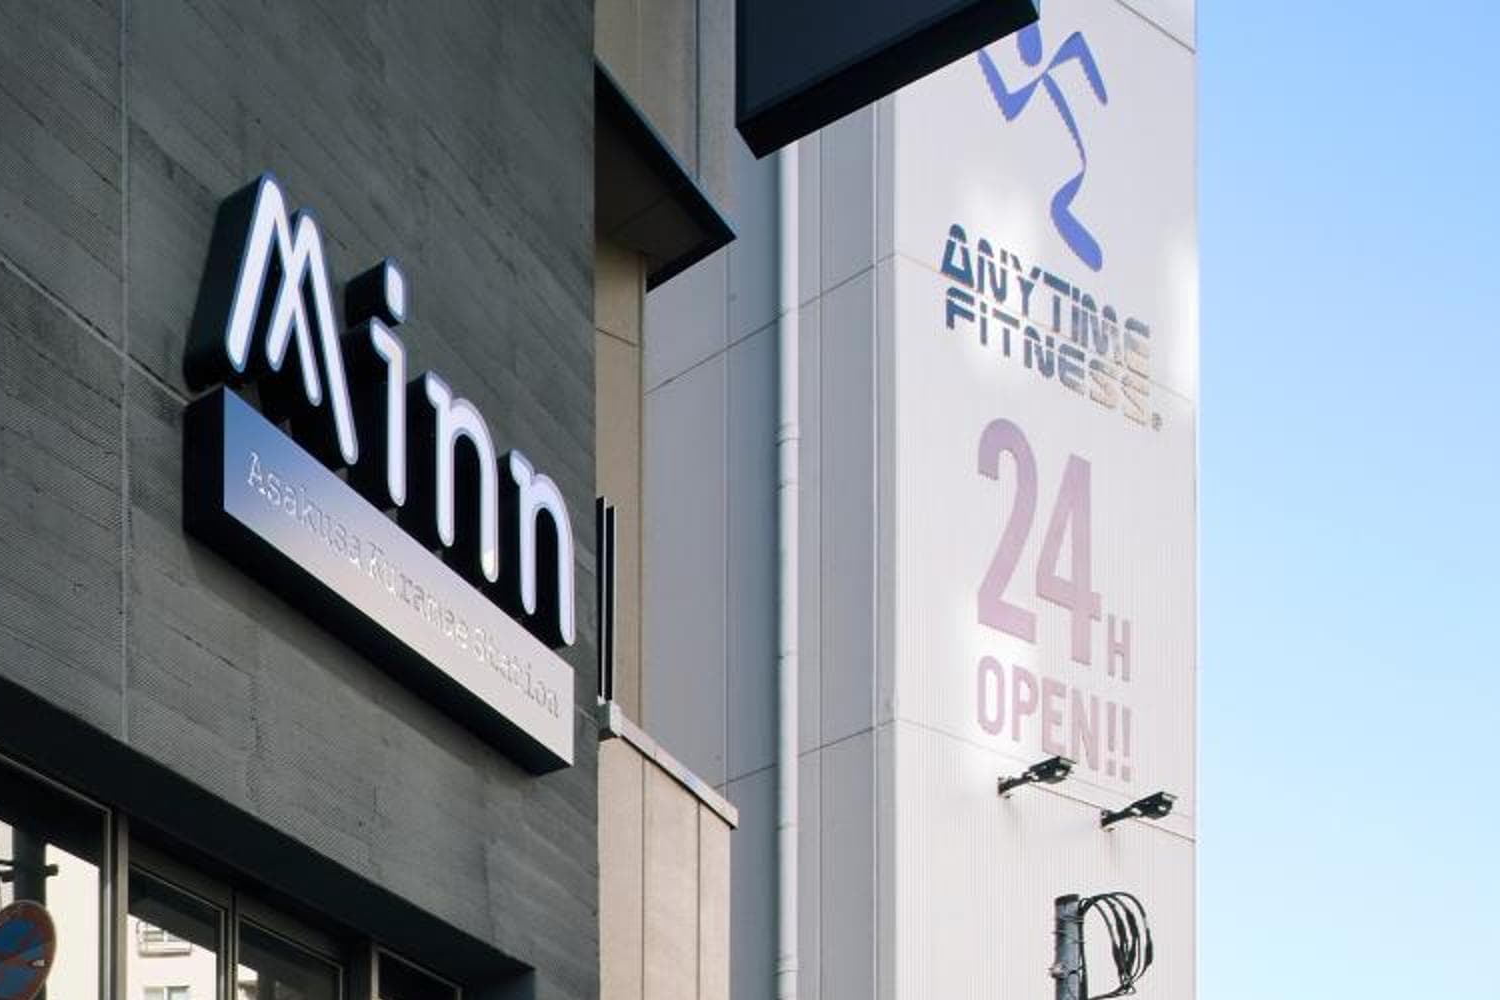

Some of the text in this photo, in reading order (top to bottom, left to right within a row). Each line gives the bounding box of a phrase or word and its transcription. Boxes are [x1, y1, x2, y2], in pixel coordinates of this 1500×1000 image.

[940, 223, 1151, 379] ANYTIME
[225, 171, 574, 645] Minn
[247, 450, 560, 719] Asakusa Kuramae Station
[976, 655, 1133, 783] OPEN!!
